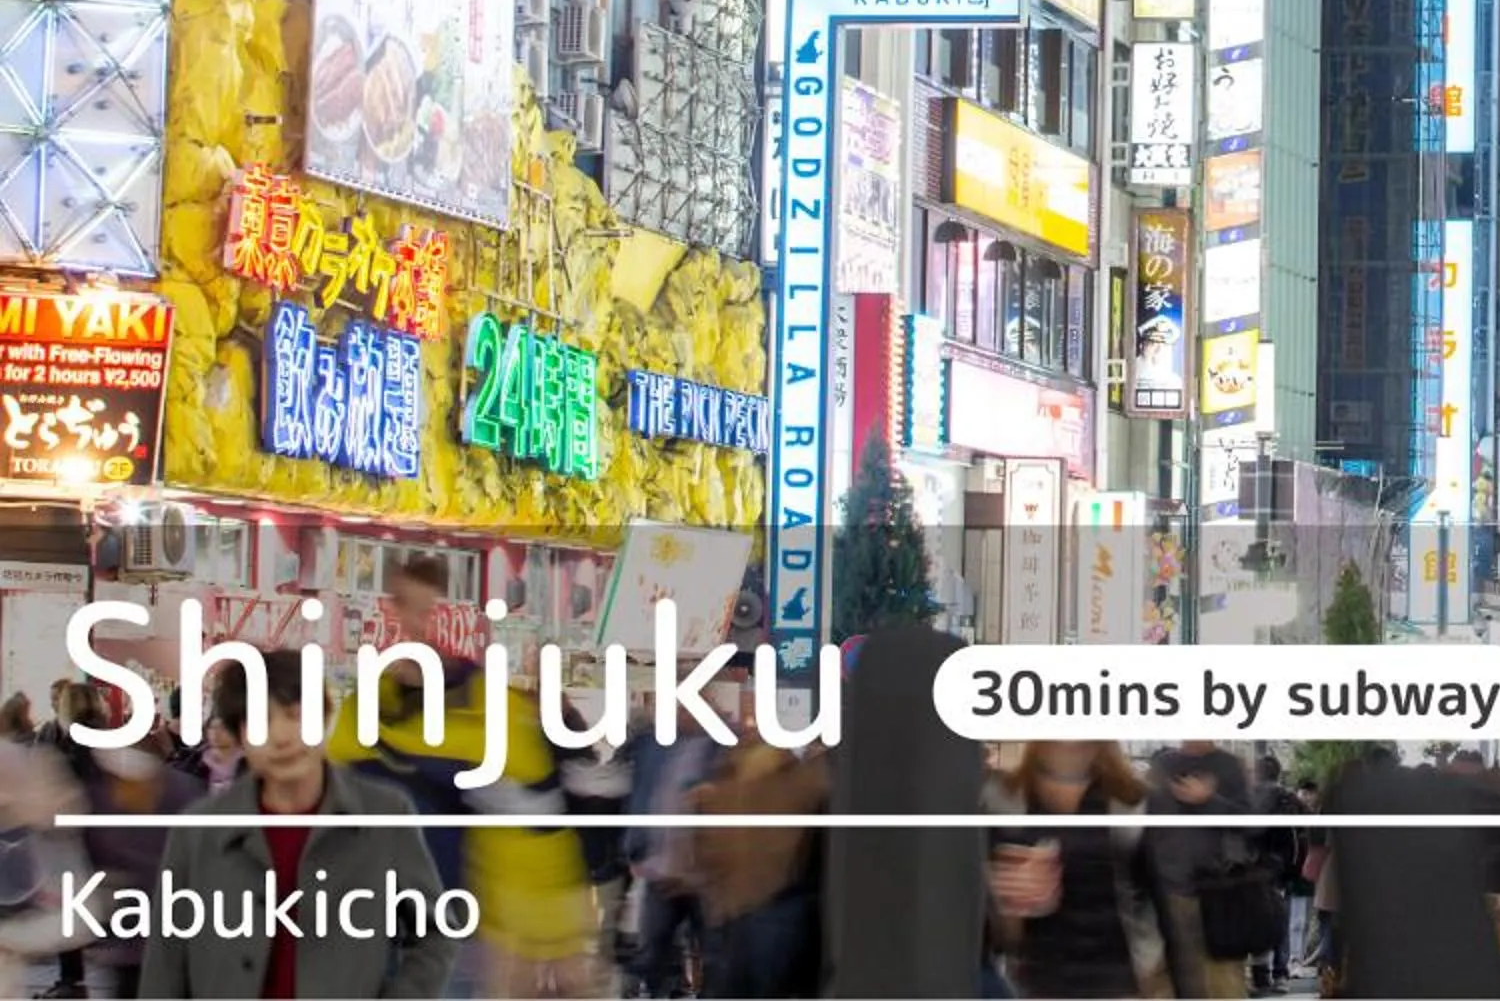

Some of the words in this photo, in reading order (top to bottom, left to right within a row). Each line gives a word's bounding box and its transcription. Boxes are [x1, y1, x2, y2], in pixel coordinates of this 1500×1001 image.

[787, 76, 823, 384] GODZILLA
[1145, 224, 1175, 311] 海の家
[8, 343, 45, 361] with
[50, 344, 163, 370] Free-Flowing
[54, 298, 166, 342] YAKI
[4, 364, 29, 381] for
[33, 365, 46, 381] 2
[49, 366, 100, 383] hours
[104, 368, 160, 390] ¥2,500
[466, 313, 597, 482] 24時間
[635, 372, 676, 436] THE
[781, 426, 815, 571] ROAD
